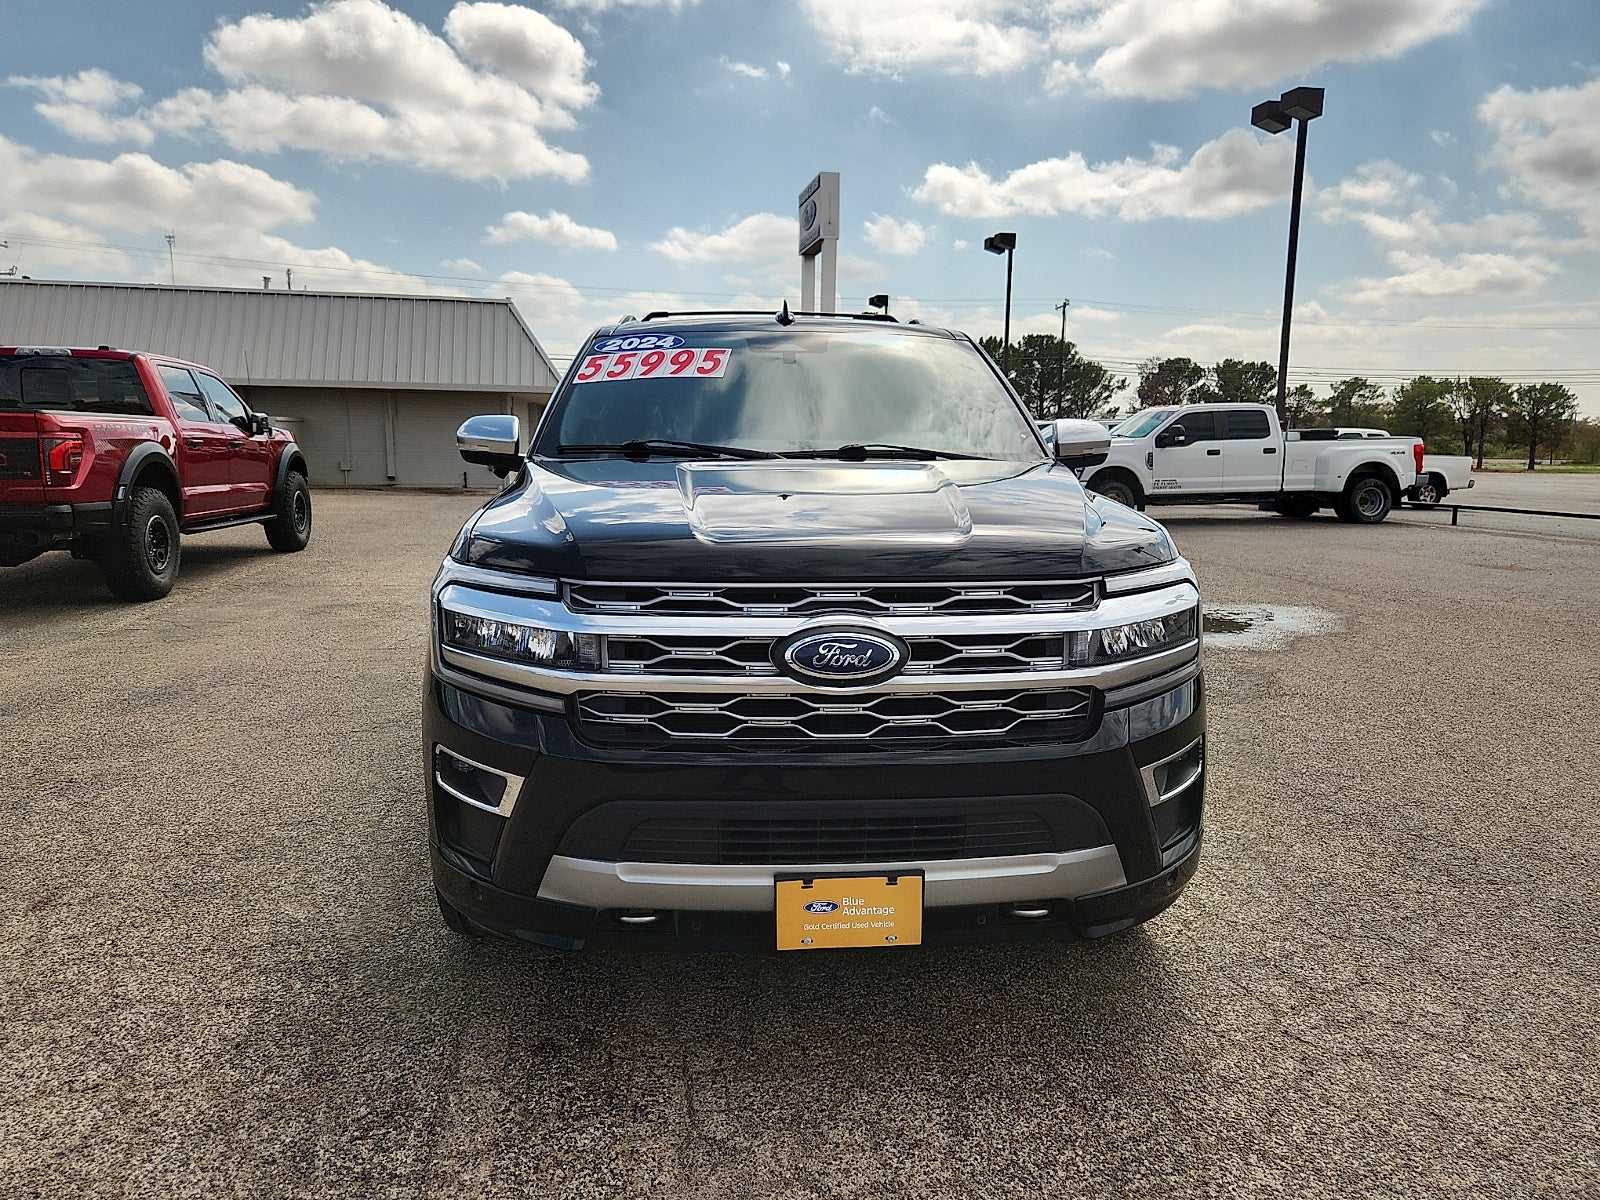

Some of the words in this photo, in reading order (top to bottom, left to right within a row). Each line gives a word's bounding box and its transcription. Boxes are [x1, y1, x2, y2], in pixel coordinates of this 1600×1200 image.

[605, 337, 674, 350] 2024
[577, 350, 727, 381] 55995
[812, 642, 873, 668] Ford
[842, 897, 865, 906] Blue
[810, 902, 833, 912] Ford
[842, 906, 895, 916] Advantage
[821, 922, 850, 930] Certified
[870, 920, 895, 928] Vehicle
